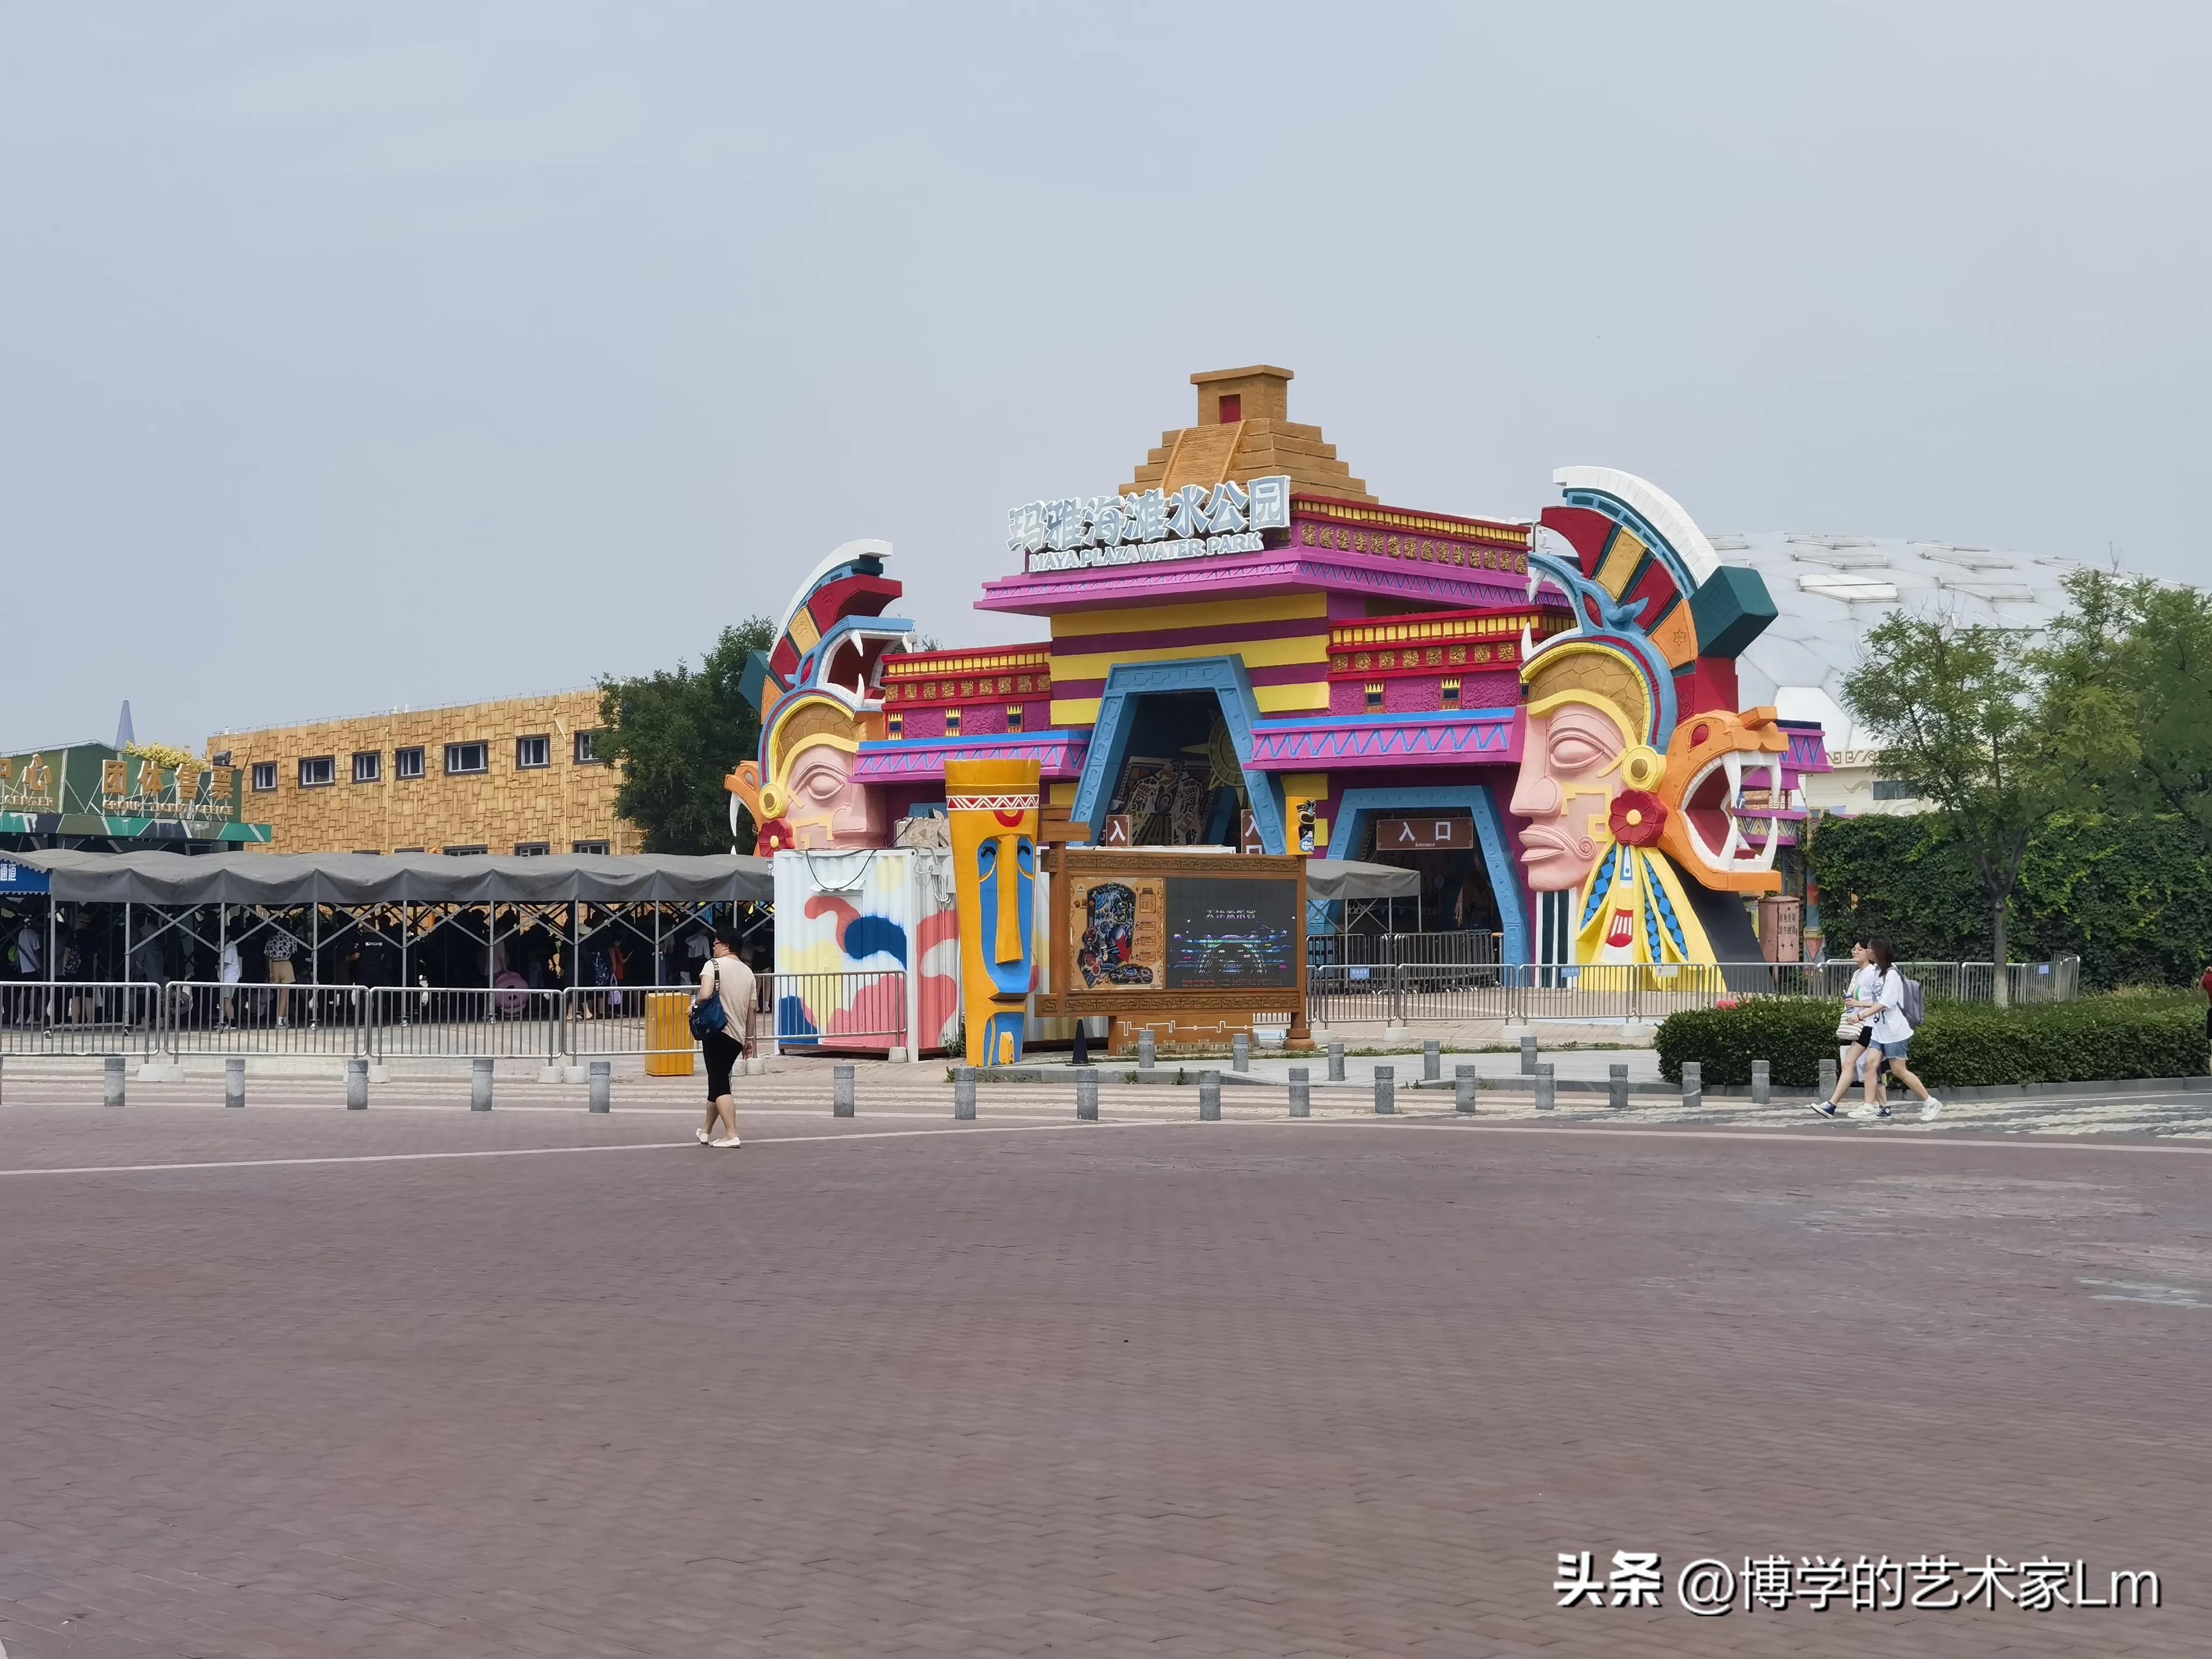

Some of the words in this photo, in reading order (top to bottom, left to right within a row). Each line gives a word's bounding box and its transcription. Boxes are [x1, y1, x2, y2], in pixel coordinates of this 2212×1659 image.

[1006, 475, 1291, 552] 玛雅海滩水公园
[1029, 550, 1081, 572] MAYA
[1081, 544, 1141, 567] PLAZA
[1138, 538, 1206, 562] WATER
[1205, 531, 1264, 556] PARK
[102, 759, 234, 800] 团体售票
[1399, 821, 1452, 842] 入口
